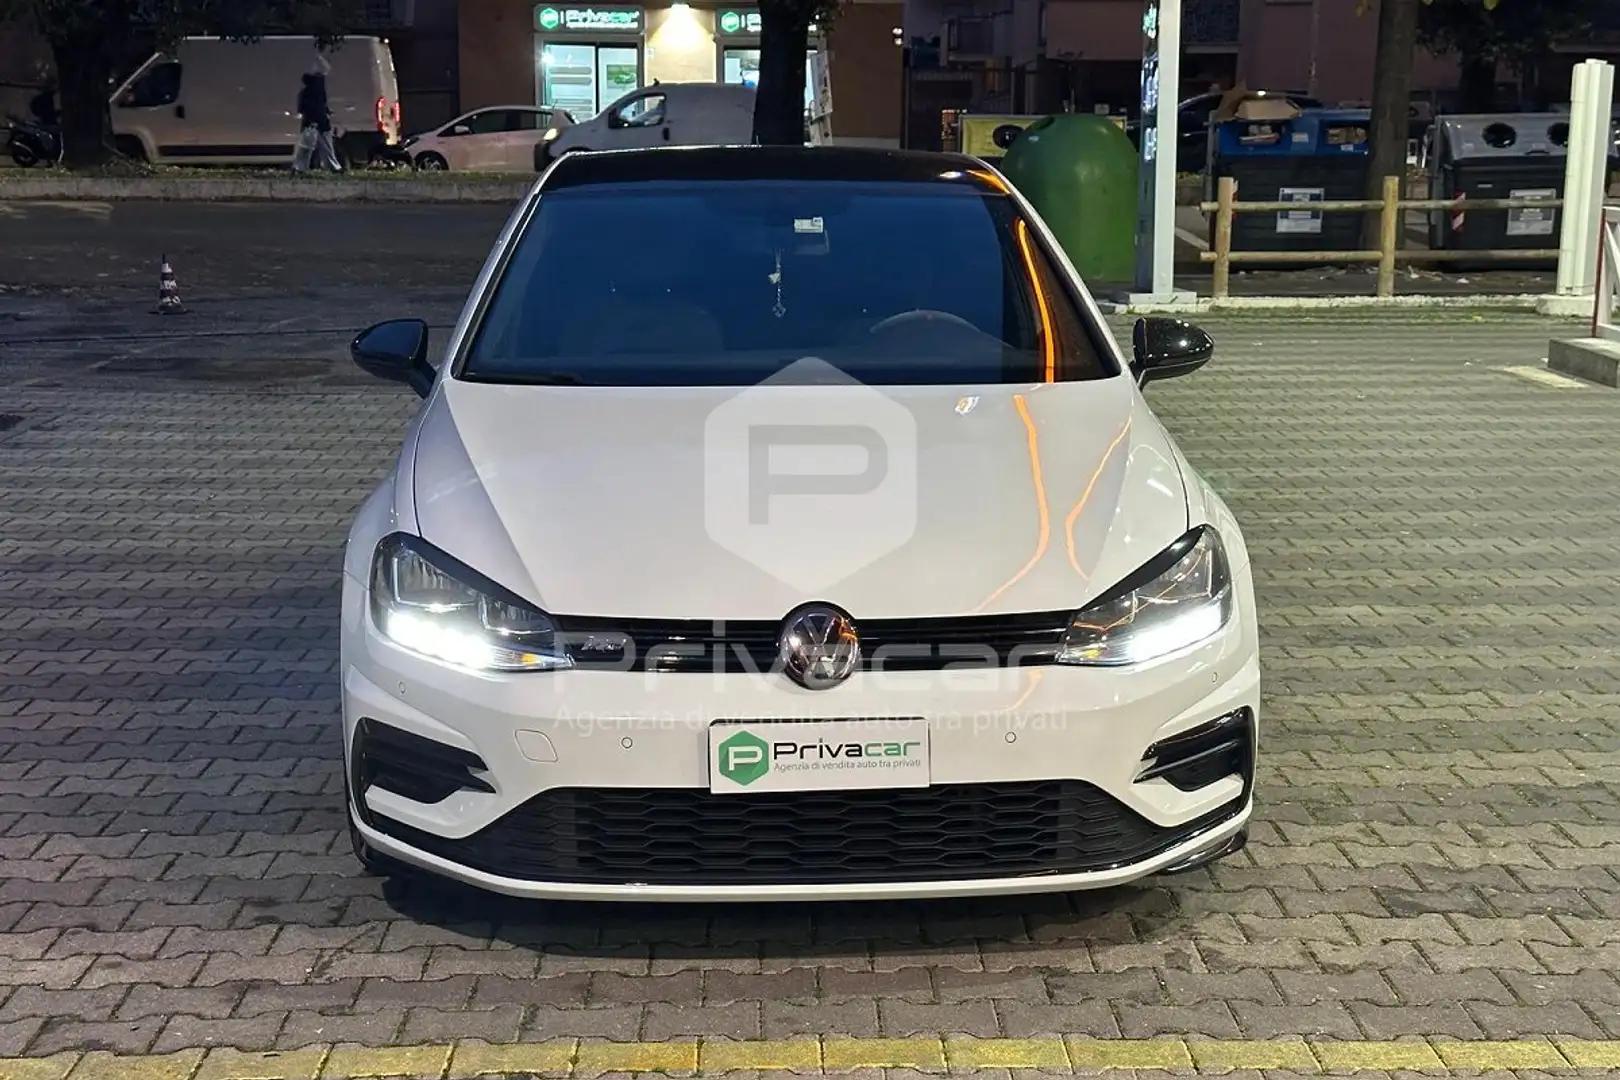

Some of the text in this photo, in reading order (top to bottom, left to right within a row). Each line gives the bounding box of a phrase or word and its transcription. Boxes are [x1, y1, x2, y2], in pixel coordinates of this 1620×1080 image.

[773, 738, 921, 760] Privacar
[774, 758, 921, 773] Agenzia di vendita auto tra privati
